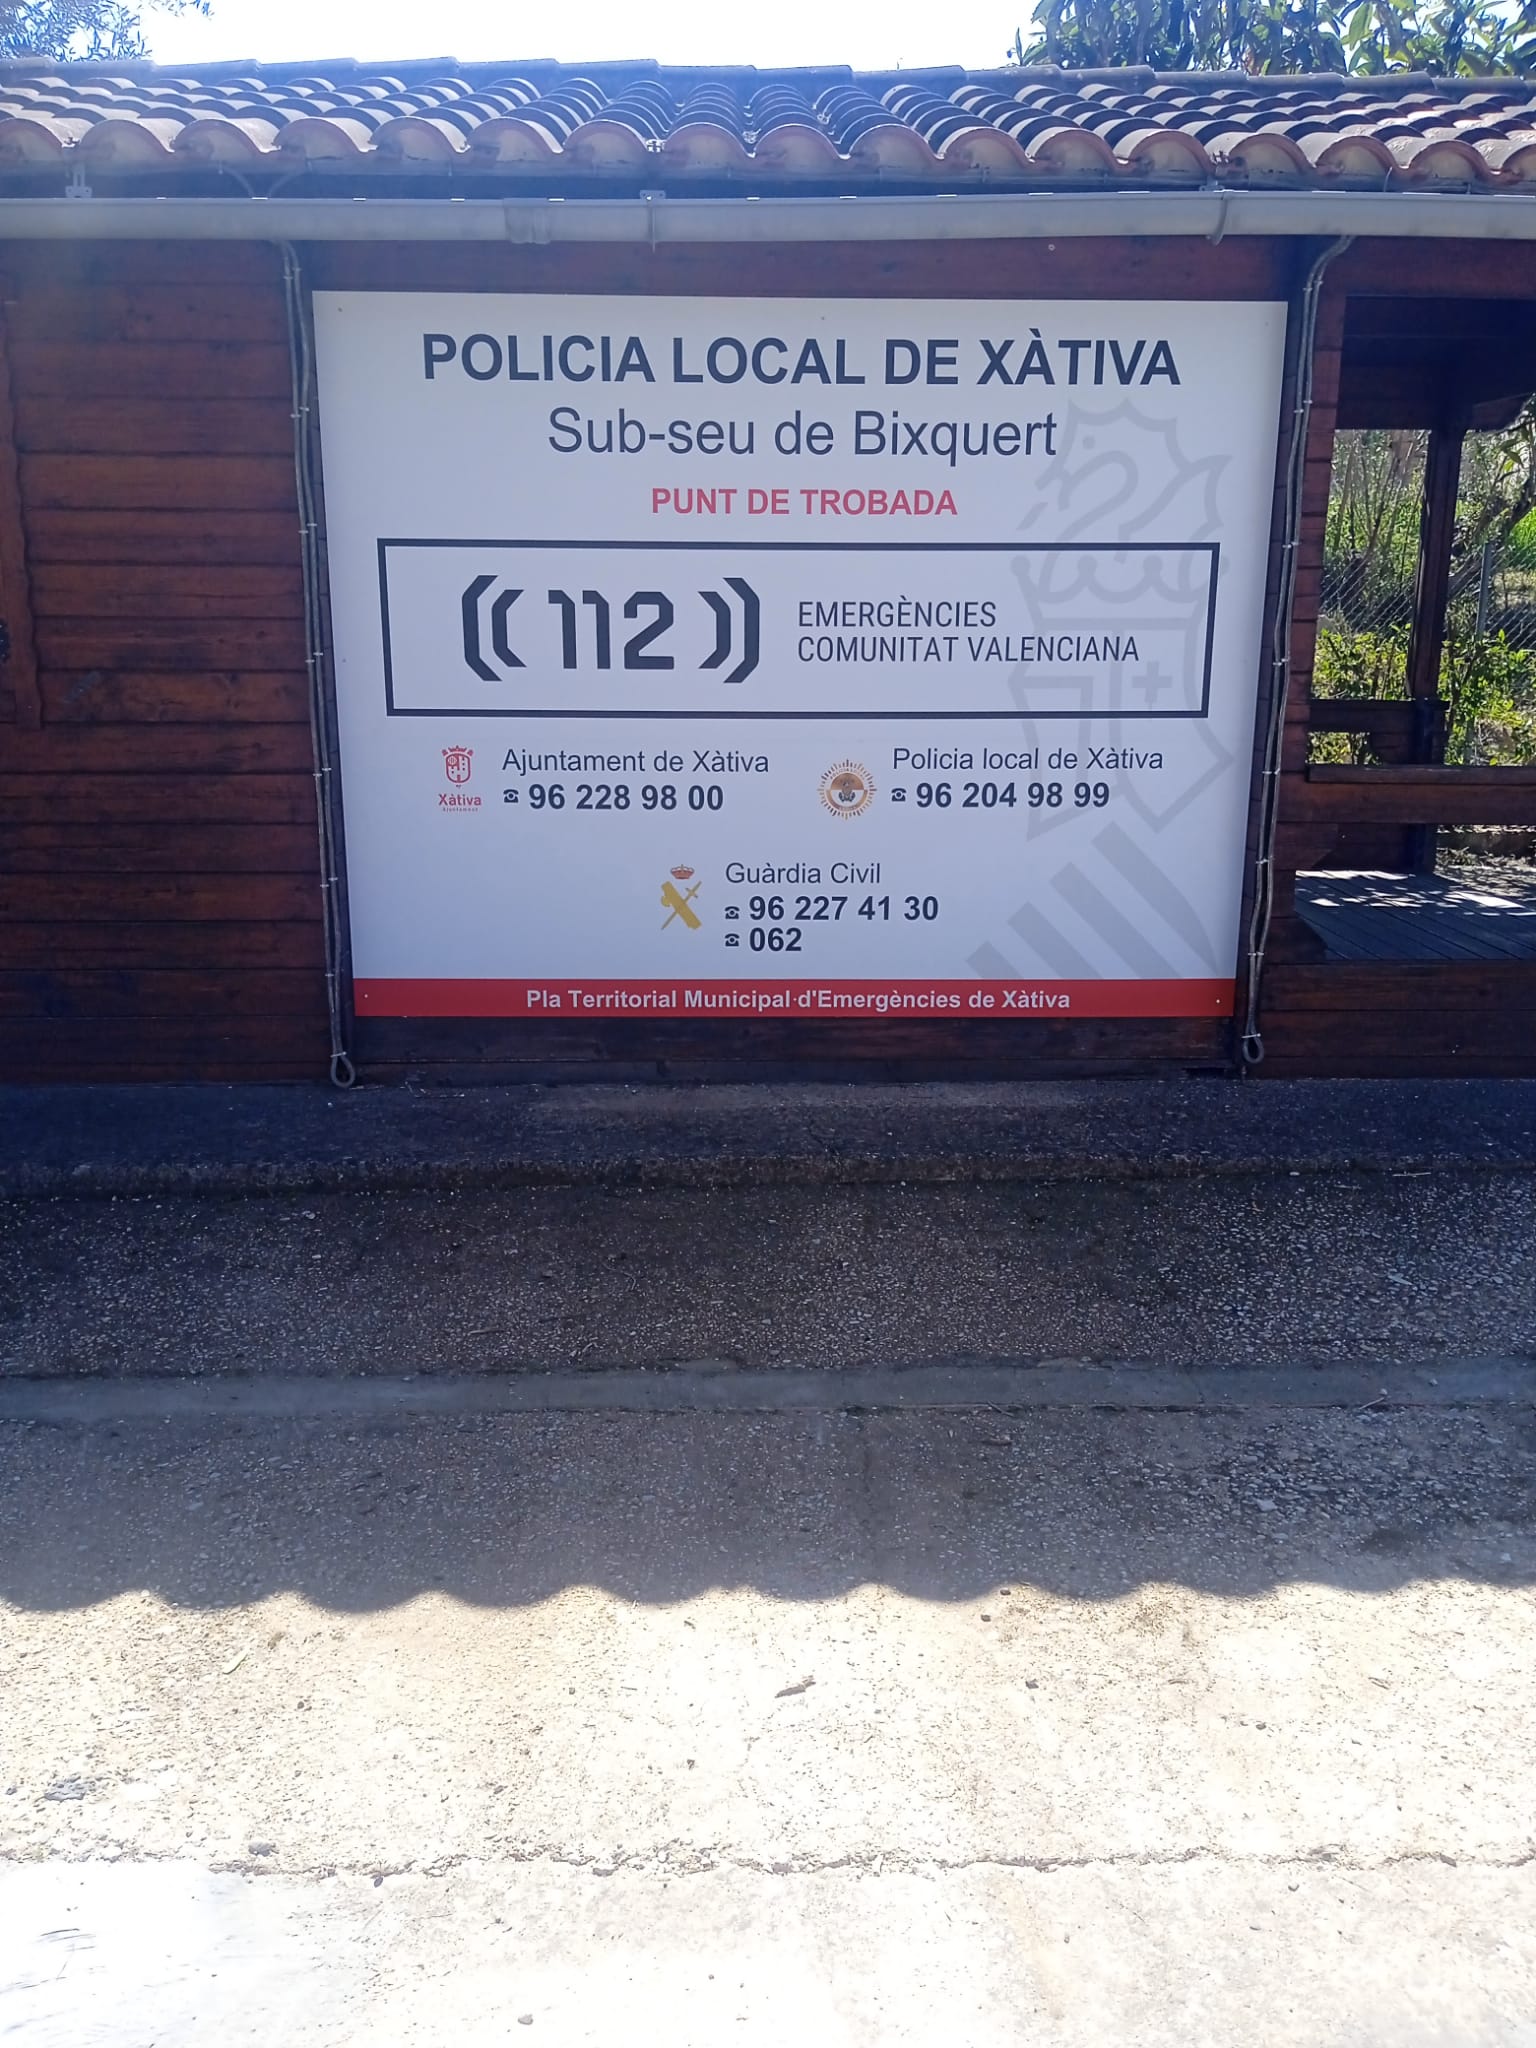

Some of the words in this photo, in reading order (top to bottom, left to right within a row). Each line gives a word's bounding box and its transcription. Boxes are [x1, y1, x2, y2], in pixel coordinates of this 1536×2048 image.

[423, 333, 656, 383] POLICIA
[672, 336, 866, 385] LOCAL
[884, 339, 959, 385] DE
[976, 328, 1181, 386] XÀTIVA
[548, 406, 754, 455] Sub-seu
[774, 409, 834, 456] de
[854, 410, 1058, 468] Bixquert
[652, 487, 738, 515] PUNT
[747, 488, 790, 515] DE
[799, 488, 958, 516] TROBADA
[798, 594, 997, 628] EMERGÈNCIES
[798, 636, 959, 663] COMUNITAT
[967, 635, 1139, 663] VALENCIANA
[501, 748, 646, 777] Ajuntament
[653, 749, 684, 773] de
[692, 750, 769, 773] Xàtiva
[893, 747, 973, 770] Policia
[983, 747, 1039, 770] local
[1047, 747, 1078, 770] de
[1085, 746, 1163, 770] Xàtiva
[438, 793, 482, 807] Xàtiva
[528, 783, 566, 810] 96
[575, 783, 631, 811] 228
[641, 784, 677, 811] 98
[688, 784, 724, 811] 00
[916, 782, 952, 808] 96
[962, 782, 1018, 808] 204
[1027, 782, 1063, 808] 98
[1074, 782, 1110, 808] 99
[725, 862, 821, 884] Guàrdia
[830, 862, 881, 884] Civil
[749, 895, 785, 921] 96
[794, 895, 849, 921] 227
[857, 895, 890, 921] 41
[903, 895, 939, 921] 30
[749, 927, 802, 952] 062
[527, 990, 561, 1008] Pla
[567, 990, 677, 1008] Territorial
[684, 990, 790, 1012] Municipal
[797, 989, 961, 1013] d'Emergències
[968, 990, 995, 1008] de
[1001, 990, 1070, 1008] Xàtiva
